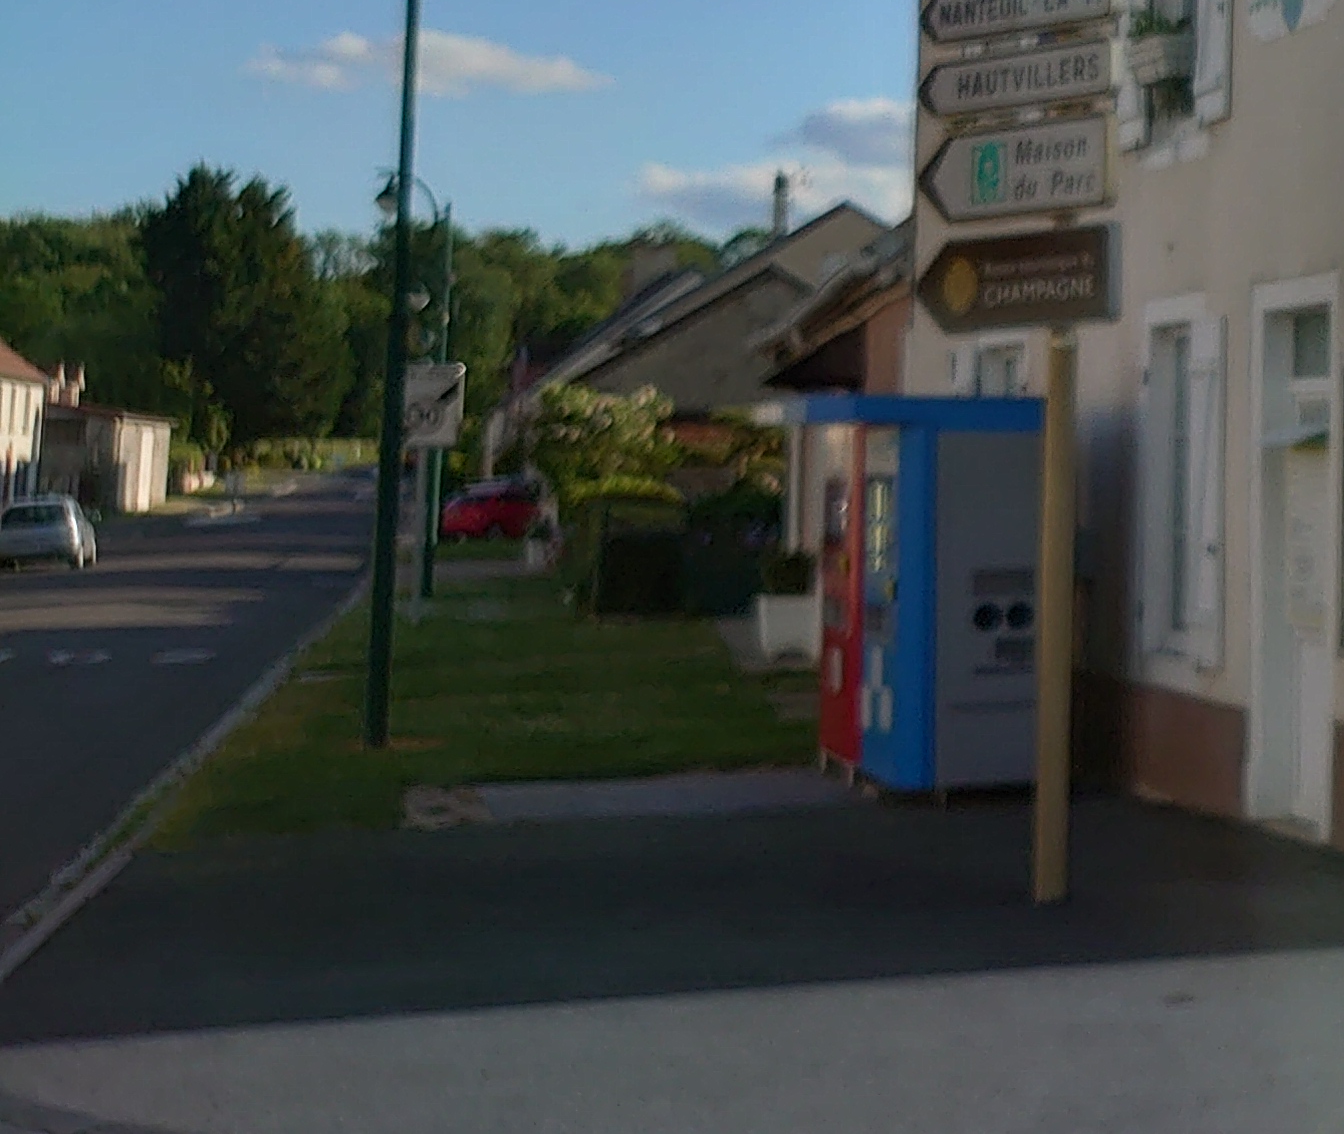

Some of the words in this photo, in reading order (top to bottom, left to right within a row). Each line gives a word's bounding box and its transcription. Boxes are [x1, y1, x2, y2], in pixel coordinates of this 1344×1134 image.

[957, 52, 1099, 100] HAUTVILLERS
[1015, 135, 1088, 165] Maison
[1014, 174, 1038, 201] du
[1050, 168, 1096, 196] Parc
[984, 274, 1095, 308] CHAMPAGNE
